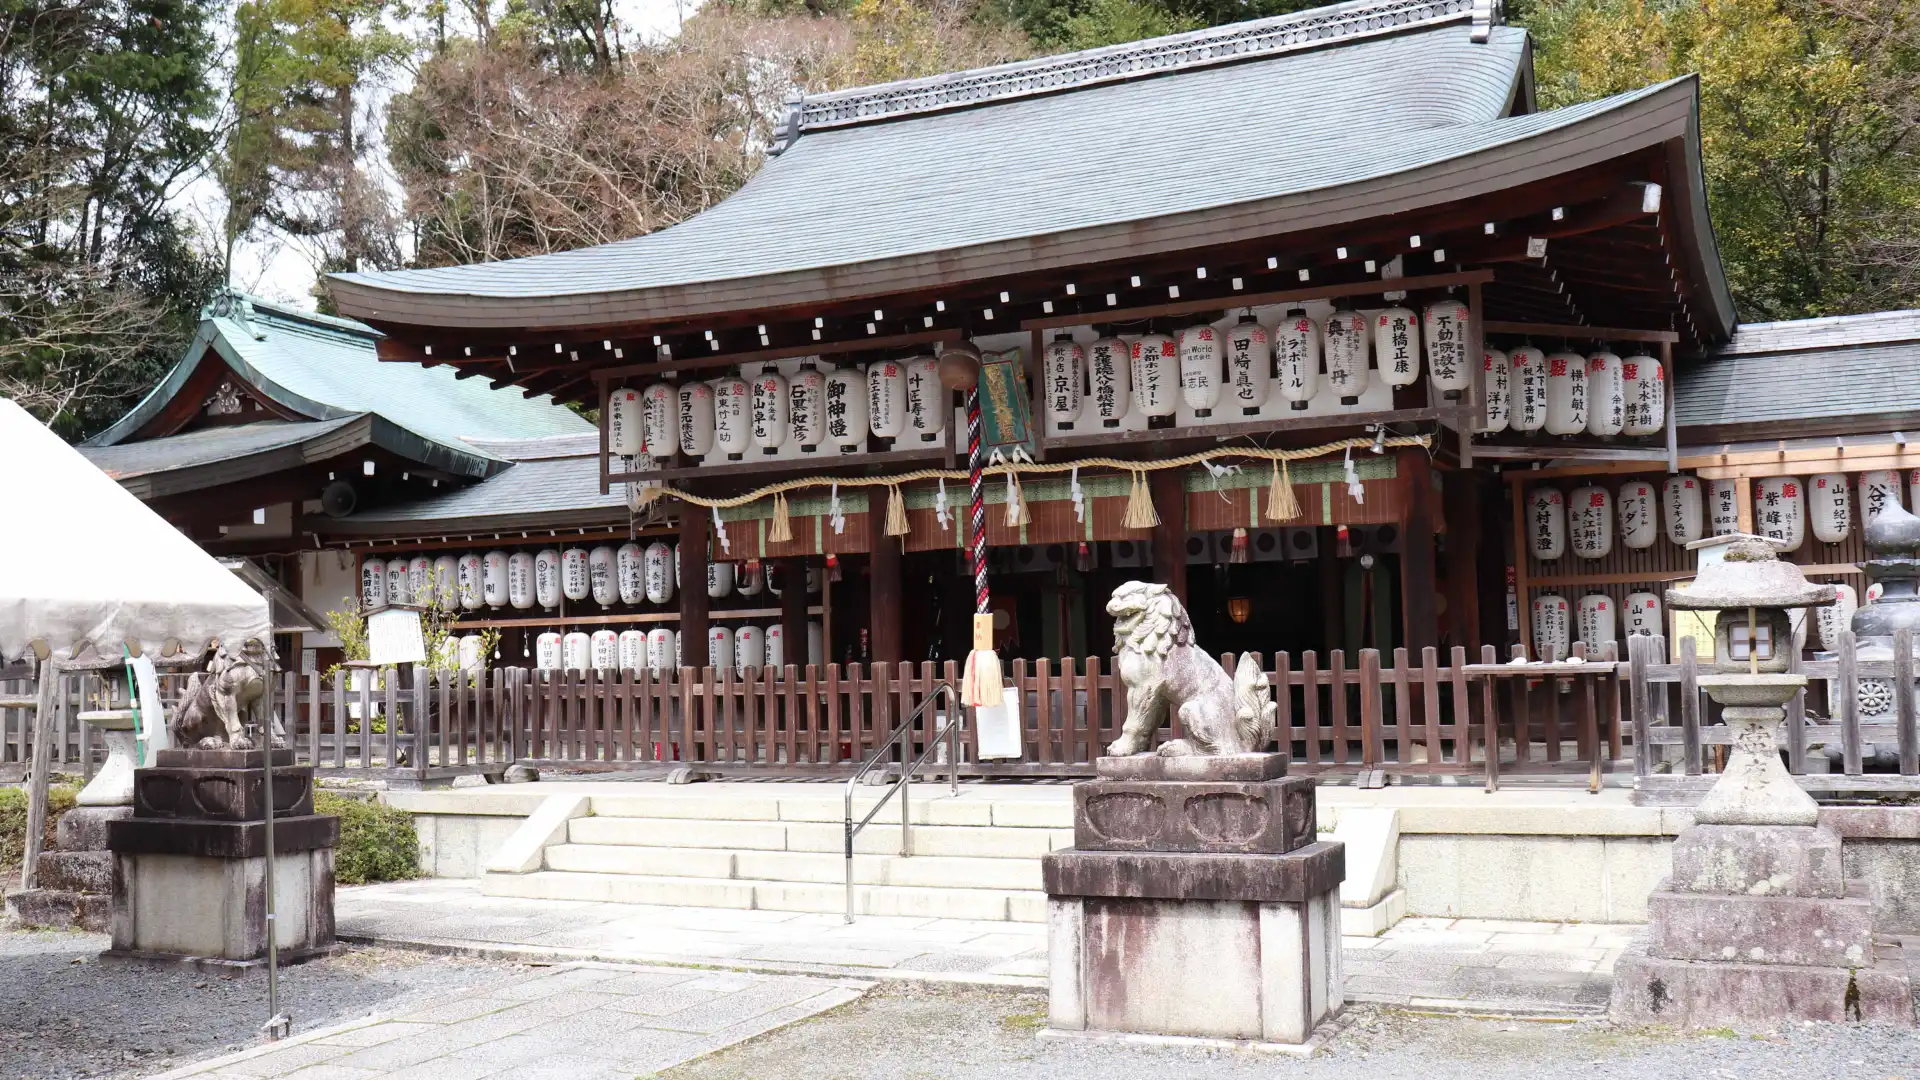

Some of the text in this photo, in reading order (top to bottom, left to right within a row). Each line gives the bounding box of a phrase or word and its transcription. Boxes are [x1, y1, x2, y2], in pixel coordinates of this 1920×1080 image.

[1191, 344, 1212, 353] World
[1287, 338, 1303, 388] ラポール
[1437, 315, 1456, 379] 不動院教会
[870, 370, 882, 430] 井上工業有限会社
[1144, 345, 1161, 406] 京都ホンダオート
[1496, 363, 1507, 390] 北村
[1522, 367, 1535, 424] 税理士事務所
[1536, 362, 1546, 408] 木下隆一
[1570, 368, 1584, 424] 横内敏人
[717, 386, 731, 442] 坂東竹之助
[826, 379, 848, 438] 御神燈
[1487, 391, 1501, 420] 洋子
[1626, 402, 1639, 427] 博子
[1534, 497, 1553, 550] 今村真澄
[1621, 498, 1638, 537] アダン
[1672, 484, 1687, 538] 医療法人マキノ病院
[1719, 490, 1731, 512] 明吉
[1832, 484, 1846, 533] 山口紀子
[1582, 507, 1597, 550] 大江邦彦
[1632, 605, 1643, 626] 山口
